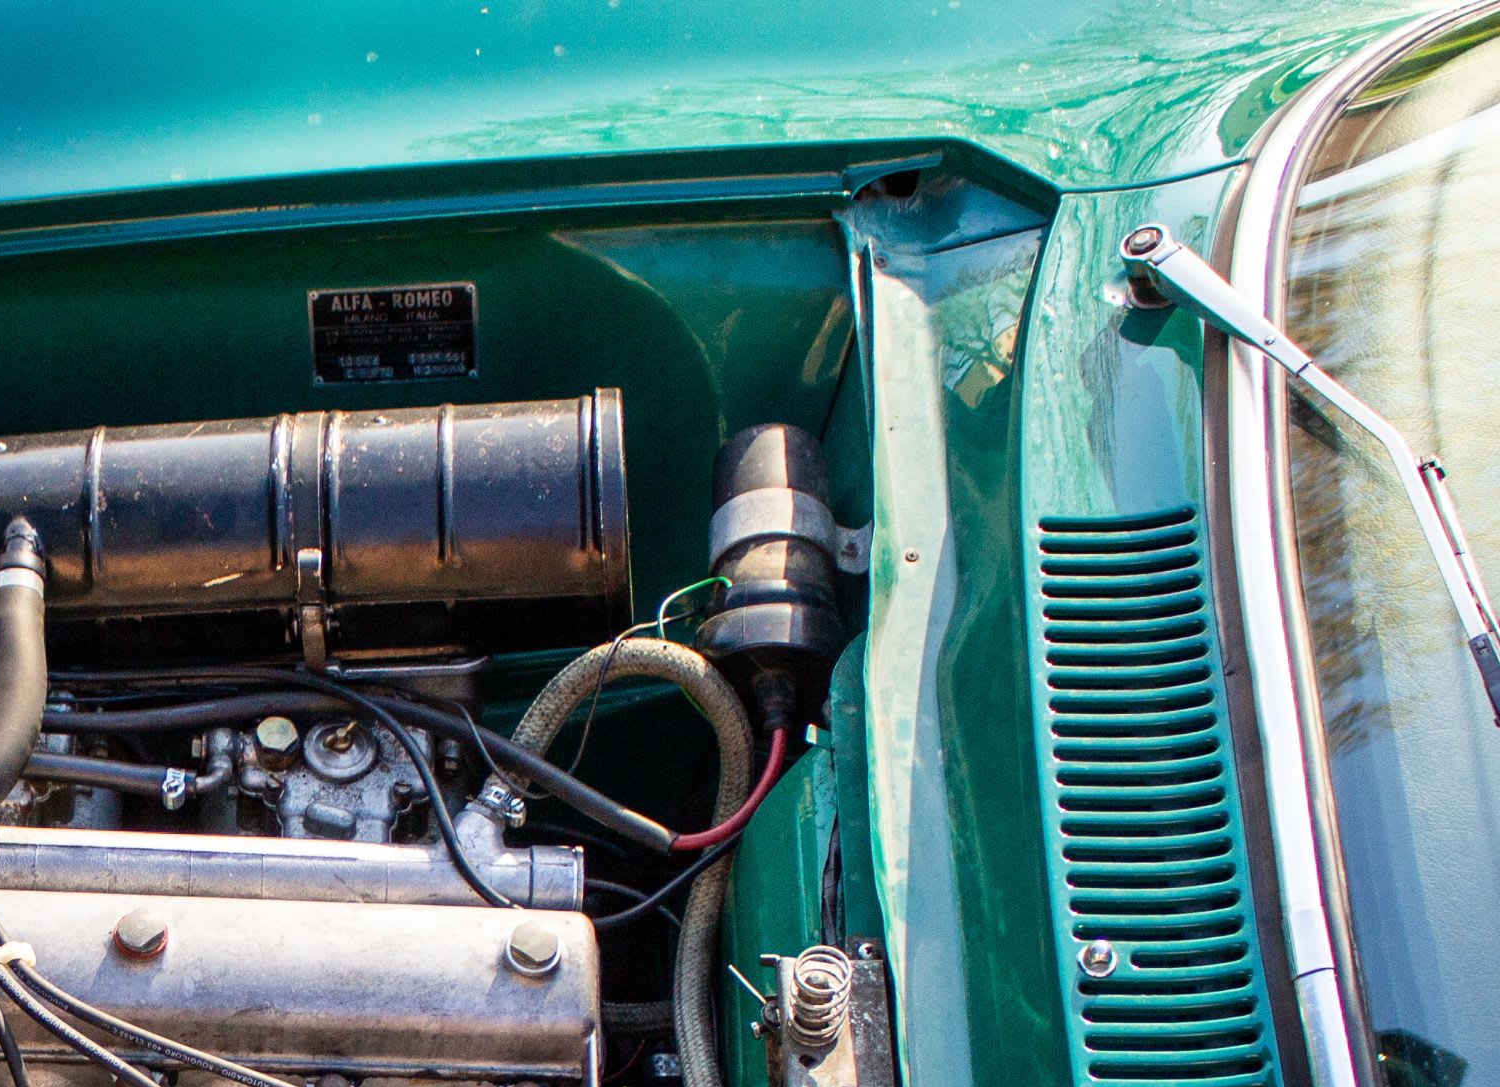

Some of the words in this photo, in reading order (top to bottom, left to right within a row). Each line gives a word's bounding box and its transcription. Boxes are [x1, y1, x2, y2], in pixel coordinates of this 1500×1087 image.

[331, 295, 372, 312] ALFA
[391, 290, 453, 309] ROMEO
[405, 310, 440, 321] ITALIA
[120, 1031, 145, 1045] CLASS
[147, 1042, 163, 1052] 403
[165, 1049, 214, 1071] BOUGICORD
